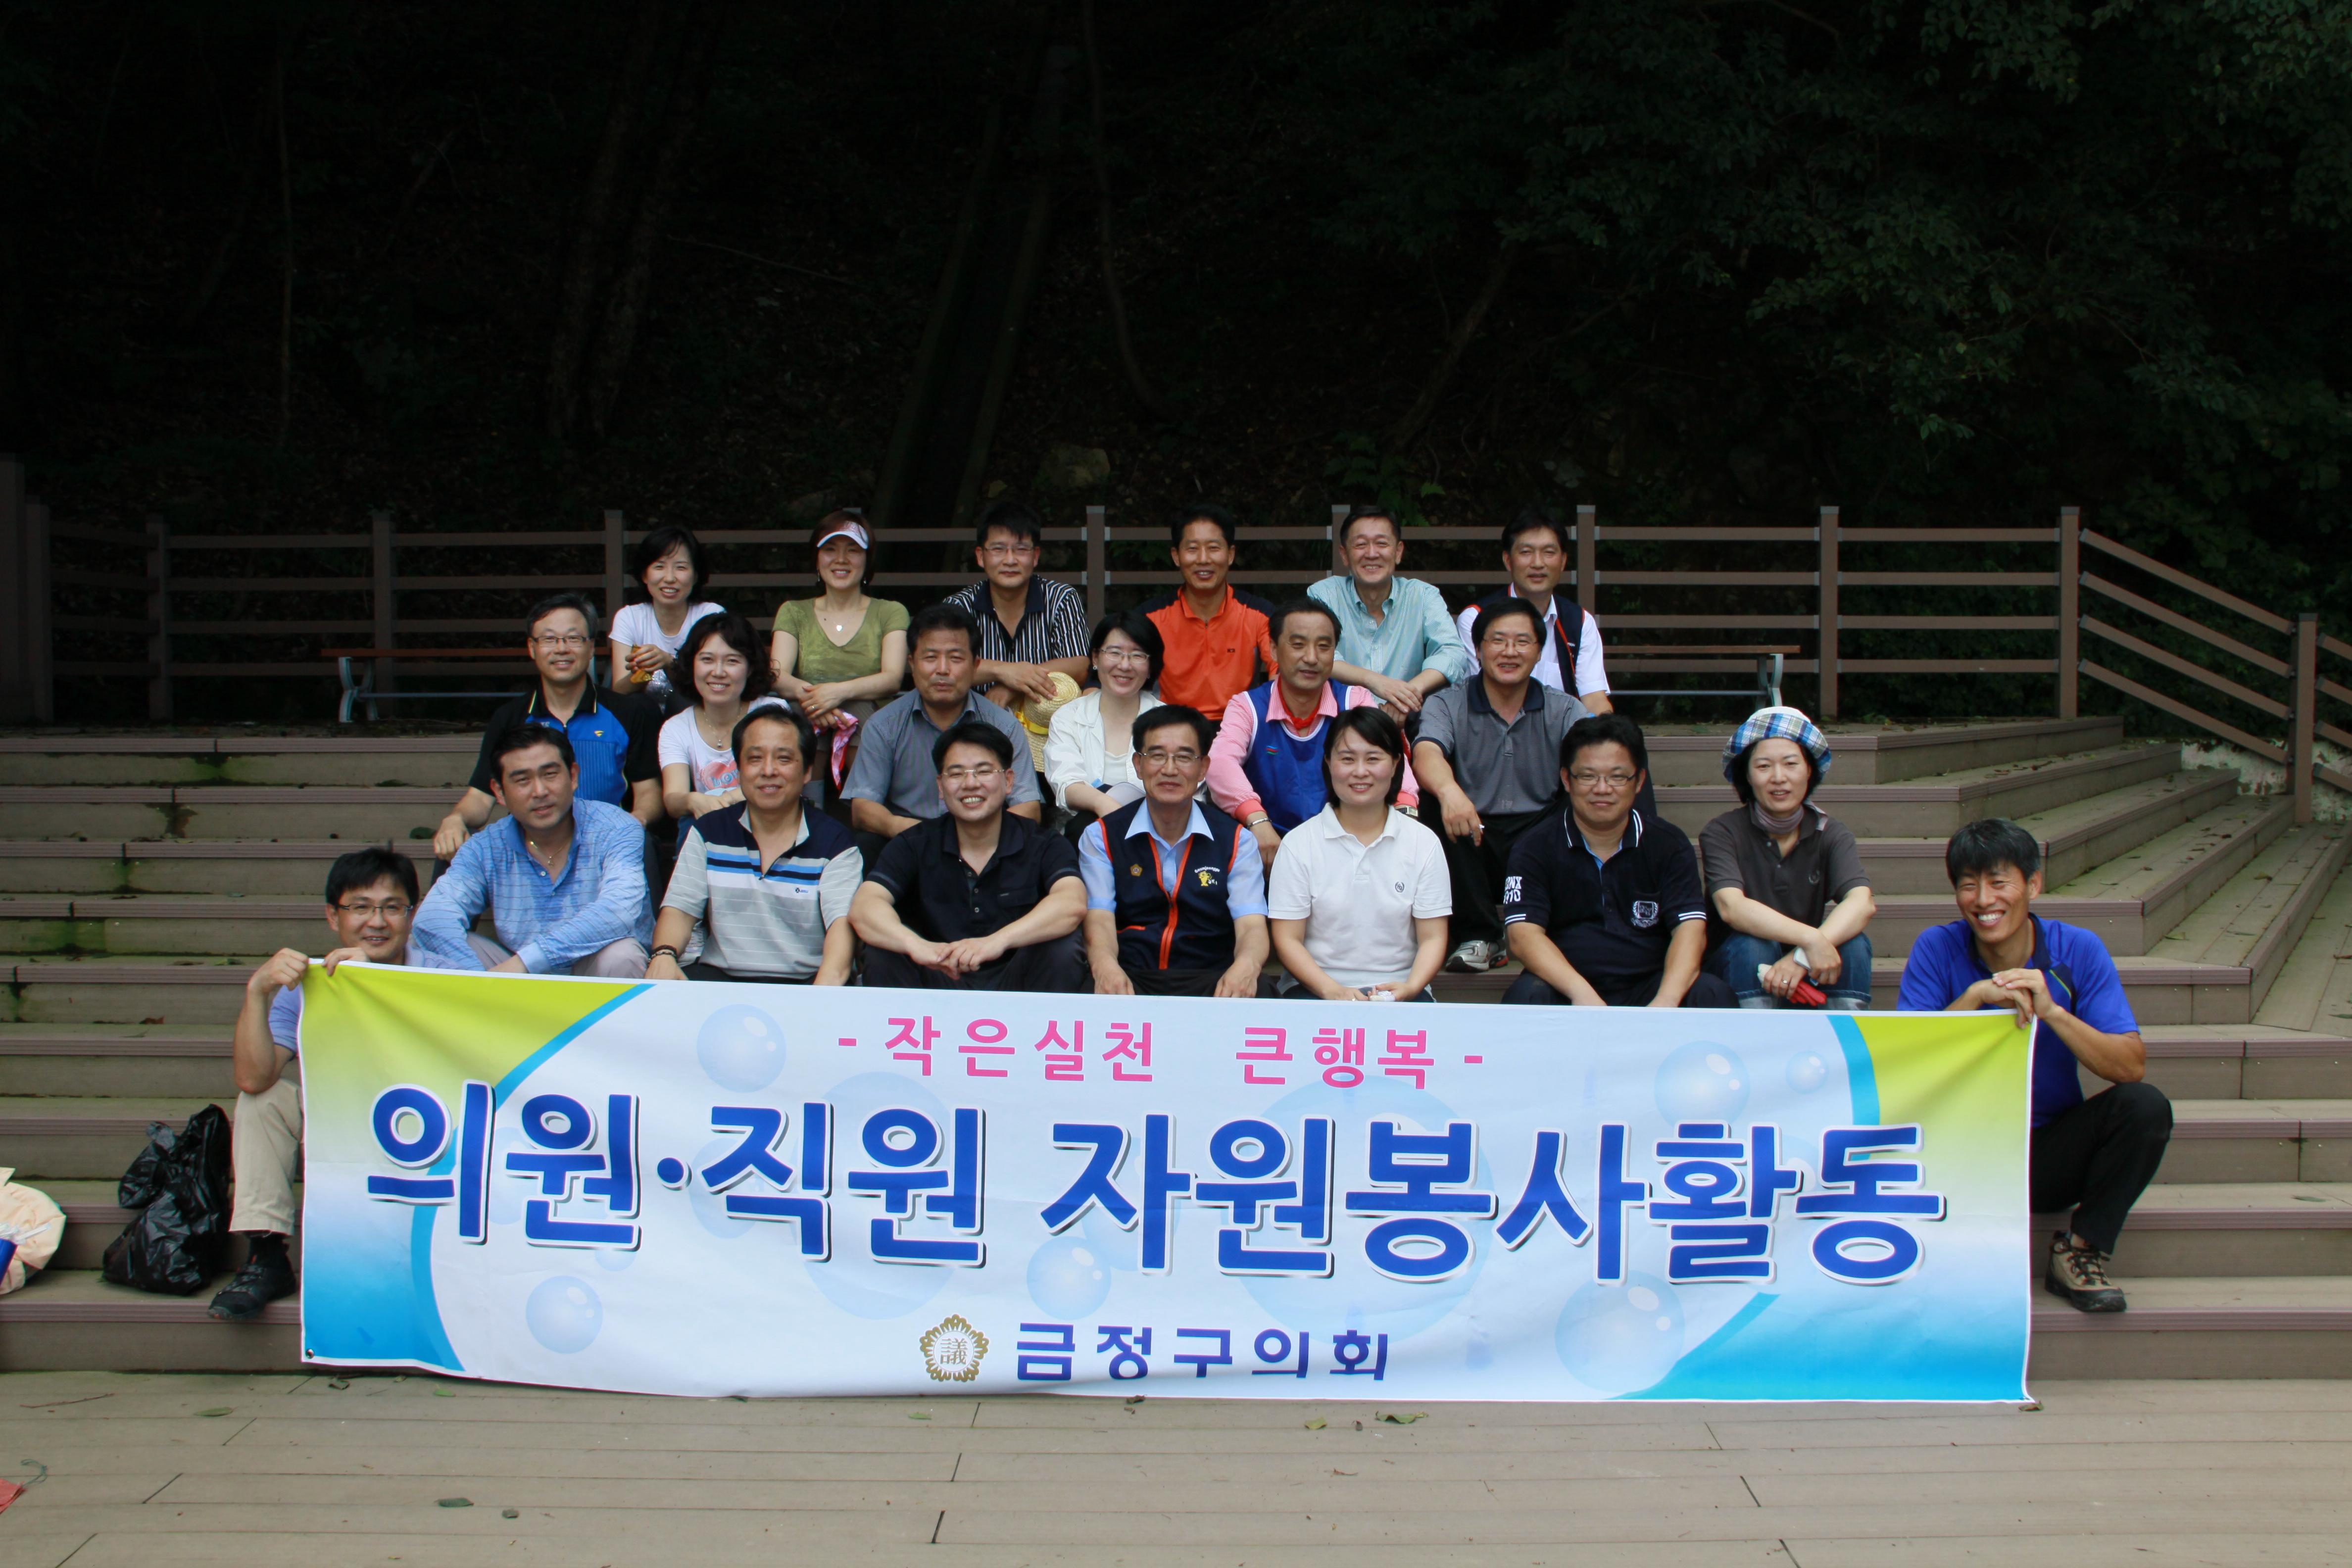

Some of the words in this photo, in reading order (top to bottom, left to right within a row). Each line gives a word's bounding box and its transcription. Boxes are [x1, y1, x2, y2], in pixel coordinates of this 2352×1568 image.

[711, 769, 739, 787] LOV
[885, 1016, 1153, 1082] 작은실천
[1235, 1027, 1435, 1089] 큰행복
[1040, 1114, 1943, 1280] 자원봉사활동
[1016, 1323, 1389, 1381] 금정구의회
